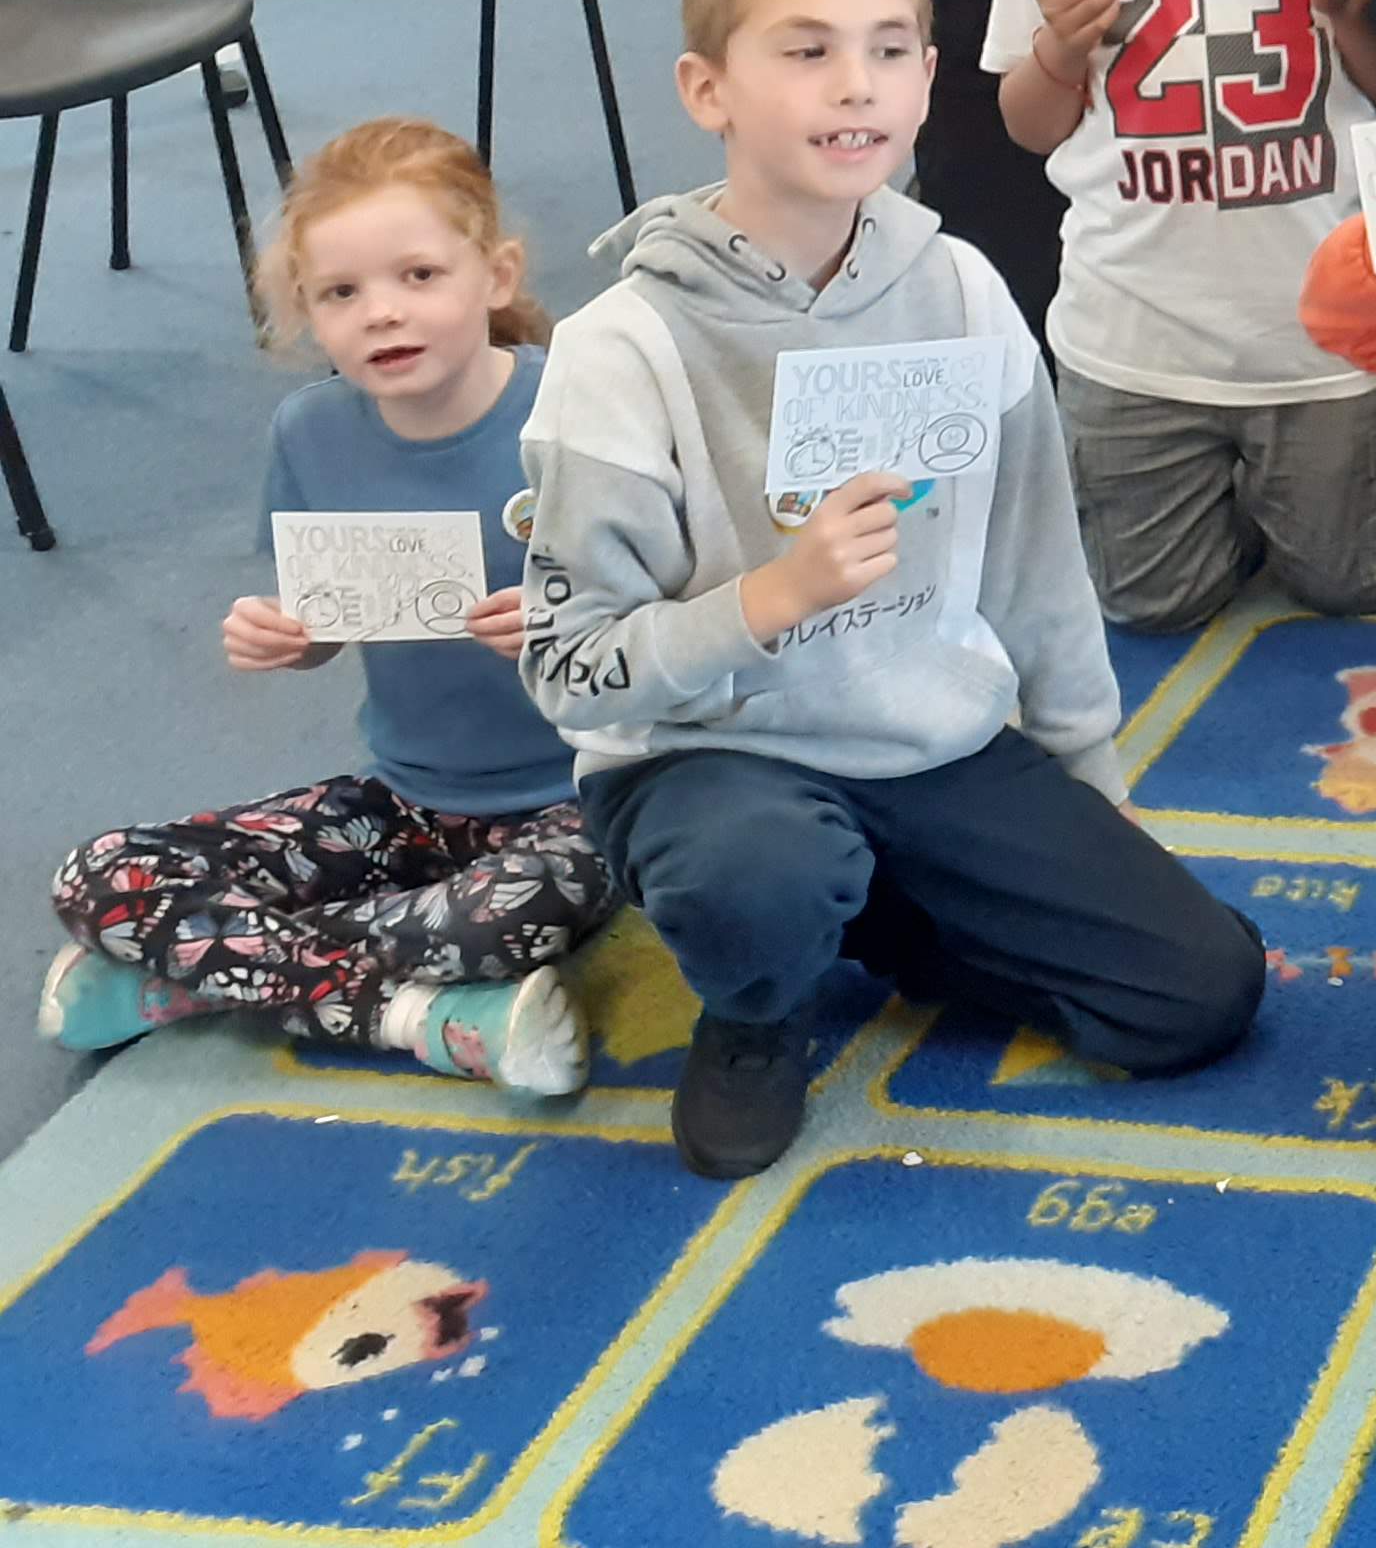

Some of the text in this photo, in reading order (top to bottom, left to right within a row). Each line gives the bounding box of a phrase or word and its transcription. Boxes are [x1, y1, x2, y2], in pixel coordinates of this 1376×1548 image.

[1116, 133, 1324, 205] JORDAN
[793, 358, 946, 396] YOURS LOVE
[1251, 874, 1363, 912] kite
[393, 1142, 541, 1203] fish
[1027, 1180, 1159, 1233] egg
